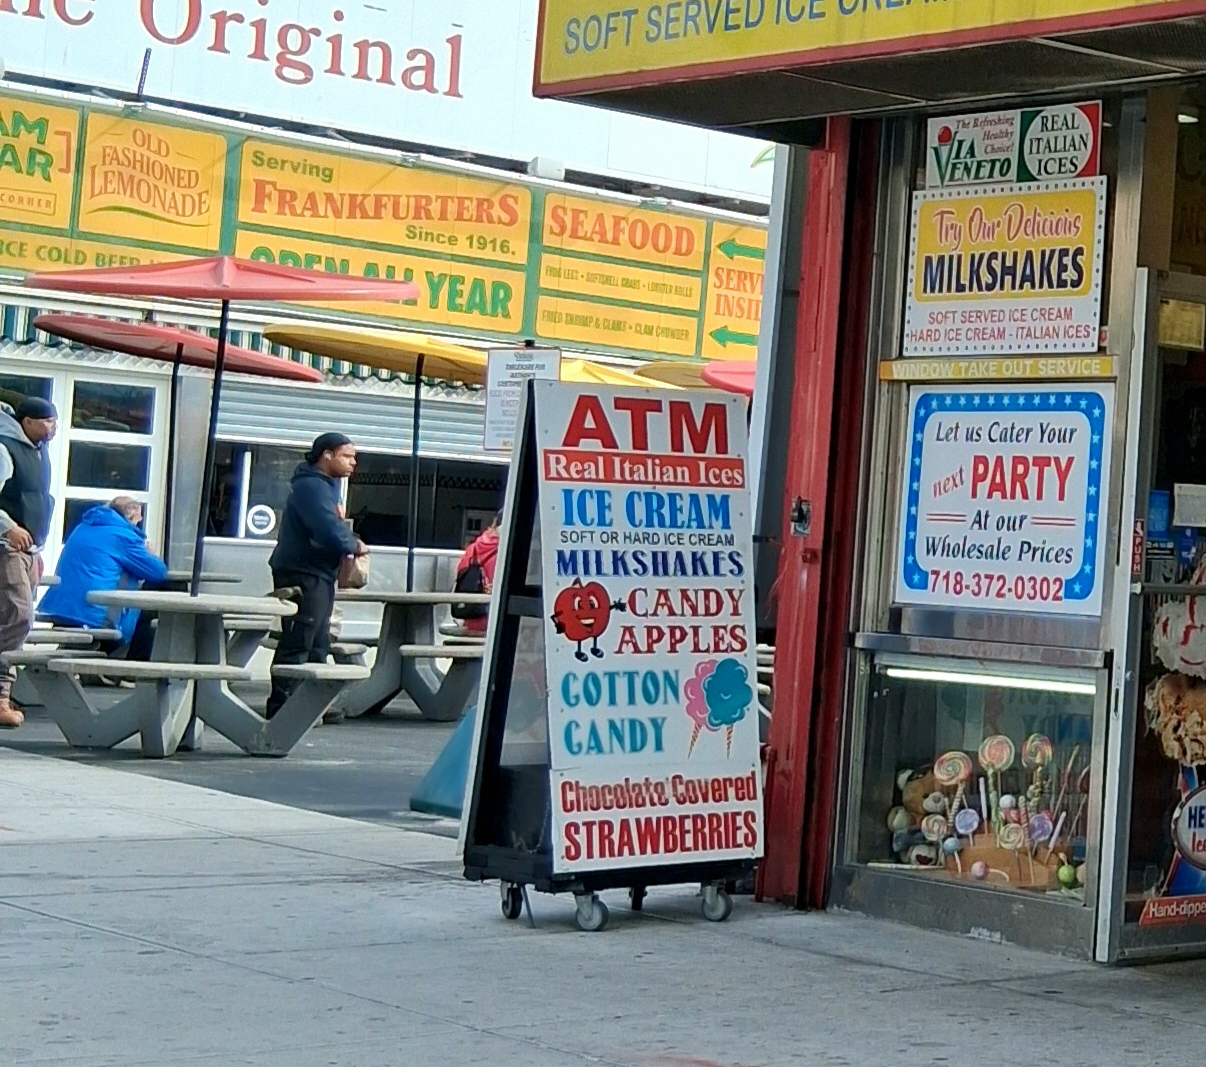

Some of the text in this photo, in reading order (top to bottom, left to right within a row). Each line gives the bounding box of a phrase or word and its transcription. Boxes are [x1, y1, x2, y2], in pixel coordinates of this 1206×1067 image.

[564, 8, 638, 57] SOFT
[955, 119, 971, 130] The
[982, 131, 1014, 141] Healthy
[1040, 113, 1080, 132] REAL
[131, 128, 171, 159] OLD
[1029, 133, 1090, 155] ITALIAN
[101, 145, 199, 190] FASHIONED
[251, 150, 334, 183] Serving
[1036, 156, 1079, 176] ICES
[89, 163, 210, 219] LEMONADE
[251, 178, 519, 227] FRANKFURTERS
[405, 224, 516, 256] Since 1916.
[550, 204, 696, 257] SEAFOOD
[933, 203, 1082, 251] Try Our Delicious
[35, 245, 88, 266] COLD
[922, 247, 1085, 294] MILKSHAKES
[425, 271, 512, 319] YEAR
[928, 307, 1073, 325] SOFT SERVED ICE CREAM
[910, 324, 1091, 342] HARD ICE CREAM ITALIAN ICES
[892, 359, 1101, 379] WINDOW TAKE OUT SERVICE
[562, 394, 729, 455] ATM
[935, 421, 1077, 444] Let us Cater Your
[547, 453, 744, 486] Real Italian Ices
[932, 454, 1075, 502] next PARTY
[562, 488, 732, 530] ICE CREAM
[969, 509, 1028, 532] At our
[560, 531, 735, 546] SOFT OR HARD ICE CREAM
[925, 535, 1074, 565] Wholesale Prices
[1133, 537, 1142, 572] PUSH
[556, 550, 745, 577] MILKSHAKES
[930, 570, 1064, 602] 718-372-0302
[627, 588, 746, 618] CANDY
[614, 624, 748, 655] APPLES
[561, 669, 681, 708] COTTON
[563, 717, 668, 755] CANDY
[561, 771, 757, 813] Chocolate Covered
[564, 810, 757, 861] STRAWBERRIES
